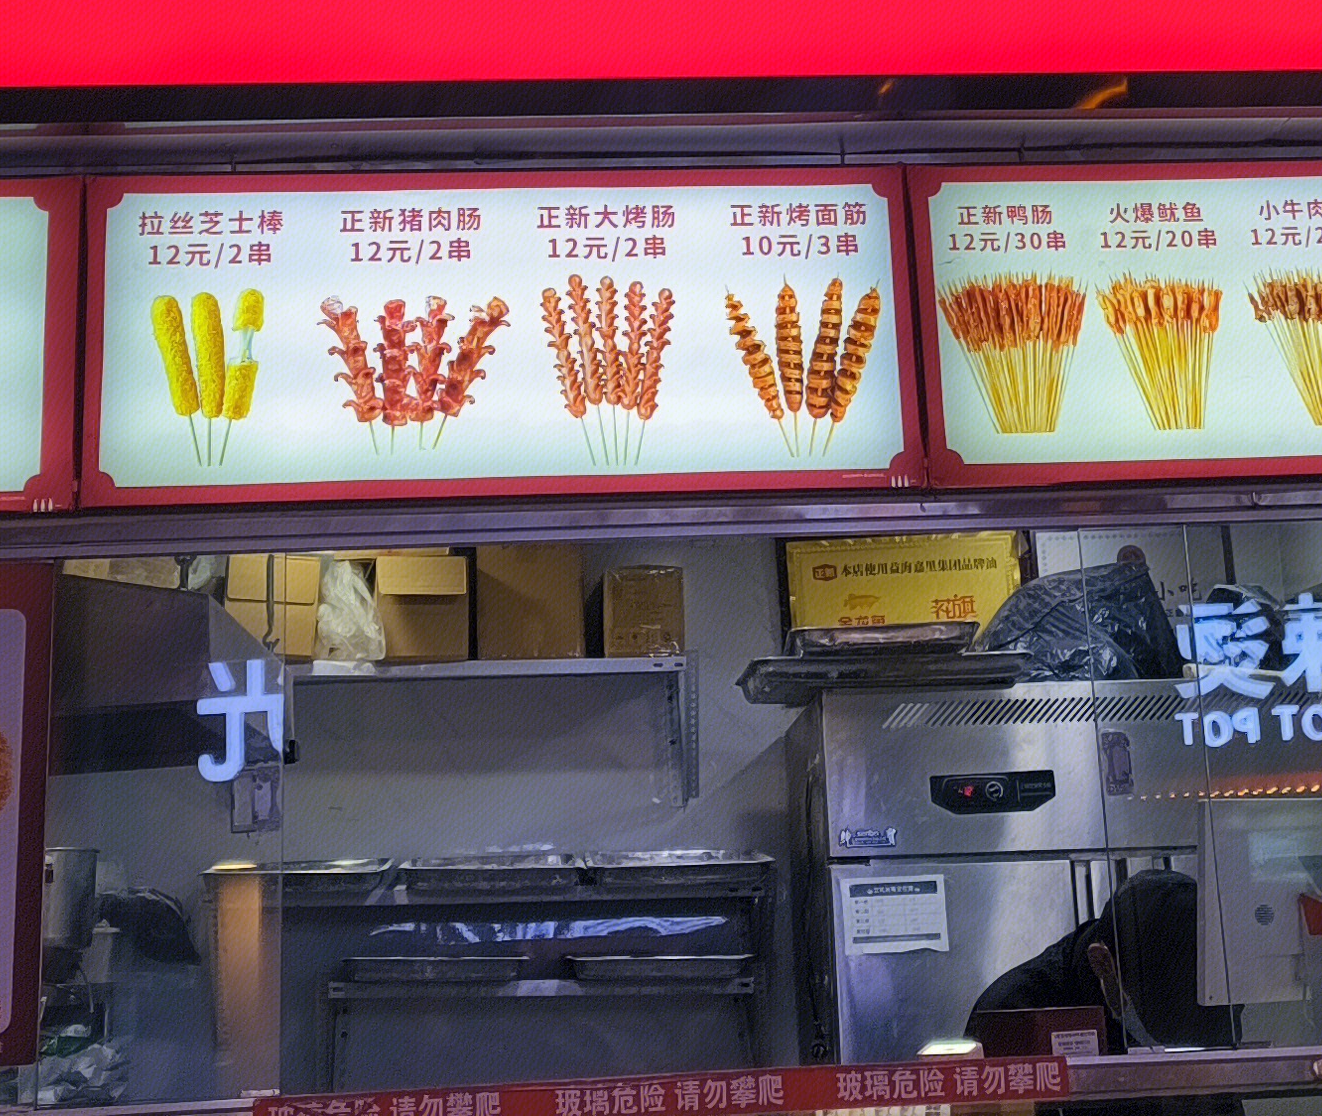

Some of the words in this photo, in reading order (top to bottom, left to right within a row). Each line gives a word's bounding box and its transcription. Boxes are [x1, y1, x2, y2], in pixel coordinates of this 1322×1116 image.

[138, 209, 284, 237] 拉丝芝士棒
[339, 206, 482, 234] 正新猪肉肠
[536, 203, 676, 230] 正新大烤肠
[729, 200, 868, 228] 正新烤面筋
[956, 203, 1054, 227] 正新鸭肠
[1108, 200, 1205, 225] 火爆鱿鱼
[349, 237, 472, 265] 12元/2串
[546, 234, 668, 262] 12元/2串
[741, 232, 860, 260] 10元/3串
[947, 230, 1067, 254] 12元/30串
[1099, 227, 1218, 252] 12元/20串
[147, 240, 273, 269] 12元/2串
[555, 1084, 667, 1115] 玻璃危险
[675, 1073, 785, 1110] 请勿攀爬
[835, 1068, 946, 1102] 玻璃危险
[953, 1060, 1062, 1096] 请勿攀爬
[389, 1092, 501, 1116] 请勿攀爬
